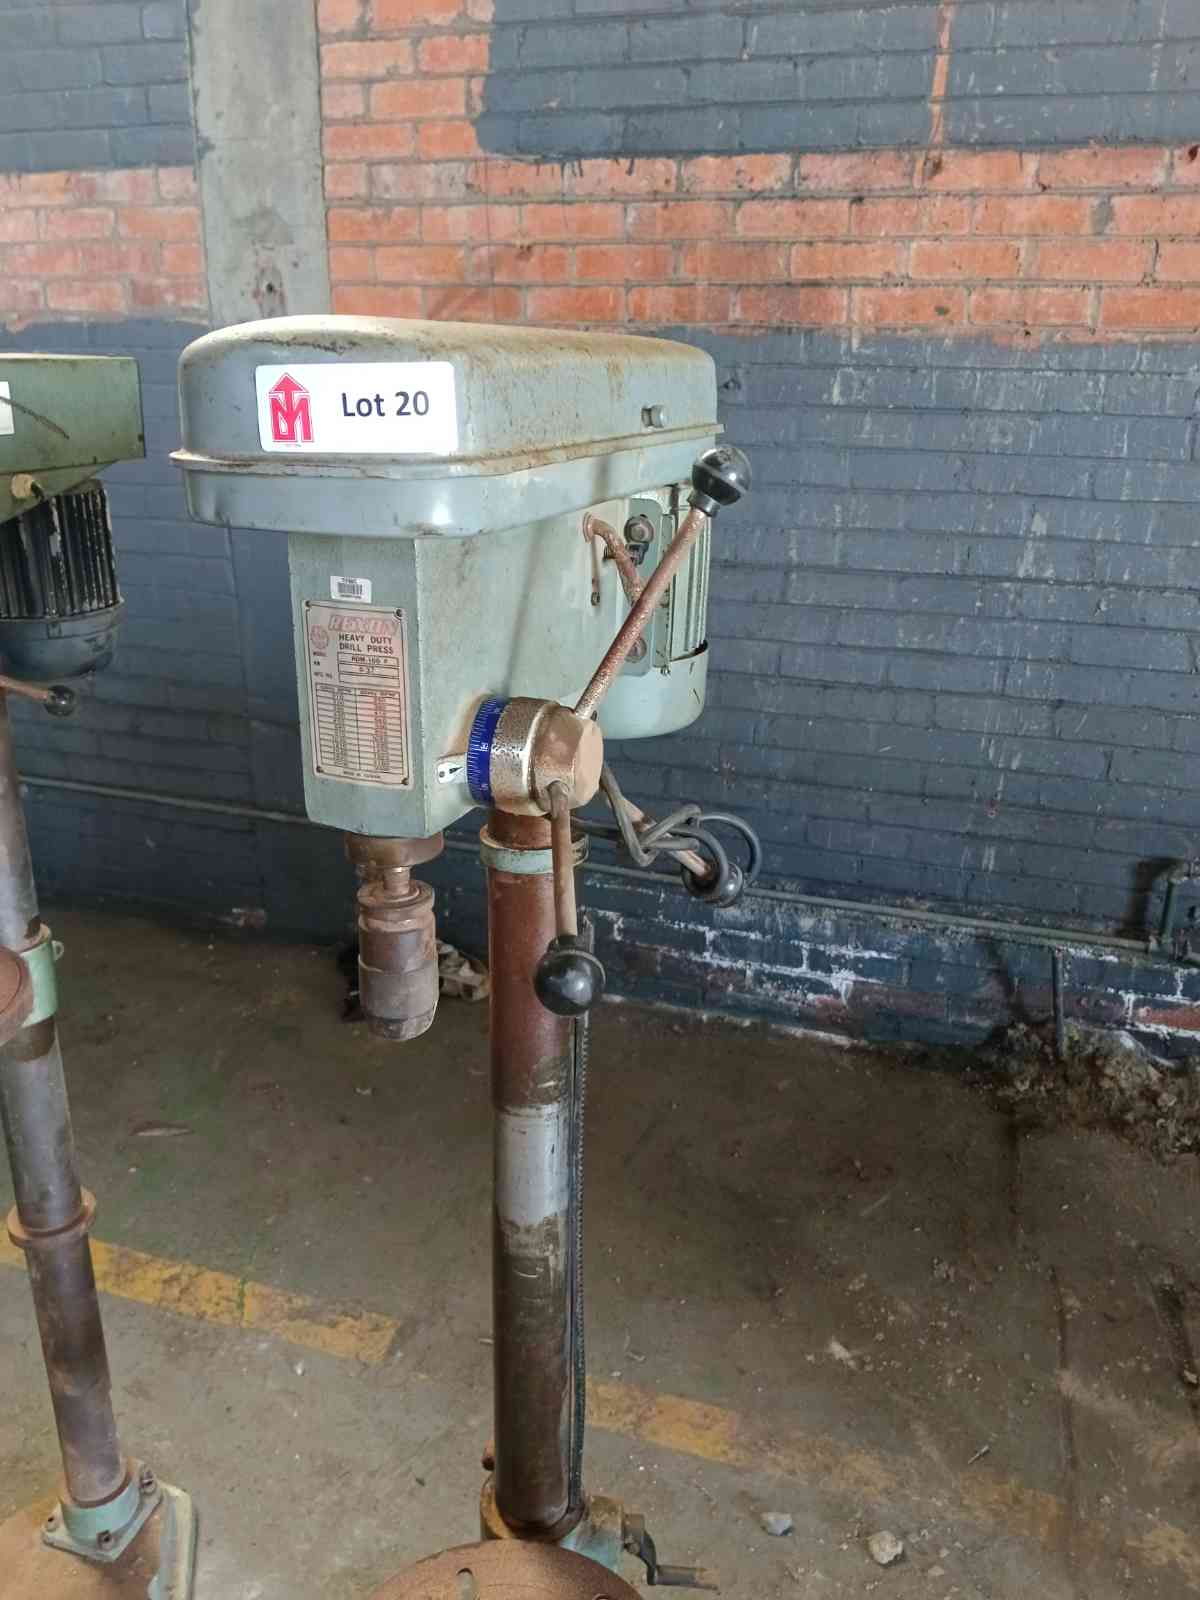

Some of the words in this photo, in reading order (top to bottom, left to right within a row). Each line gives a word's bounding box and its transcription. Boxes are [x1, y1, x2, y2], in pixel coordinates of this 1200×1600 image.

[341, 392, 386, 418] Lot
[395, 390, 429, 417] 20
[338, 633, 365, 642] HEAVY
[370, 634, 392, 645] DUTY
[339, 642, 362, 652] DRILL
[367, 644, 394, 655] PRESS
